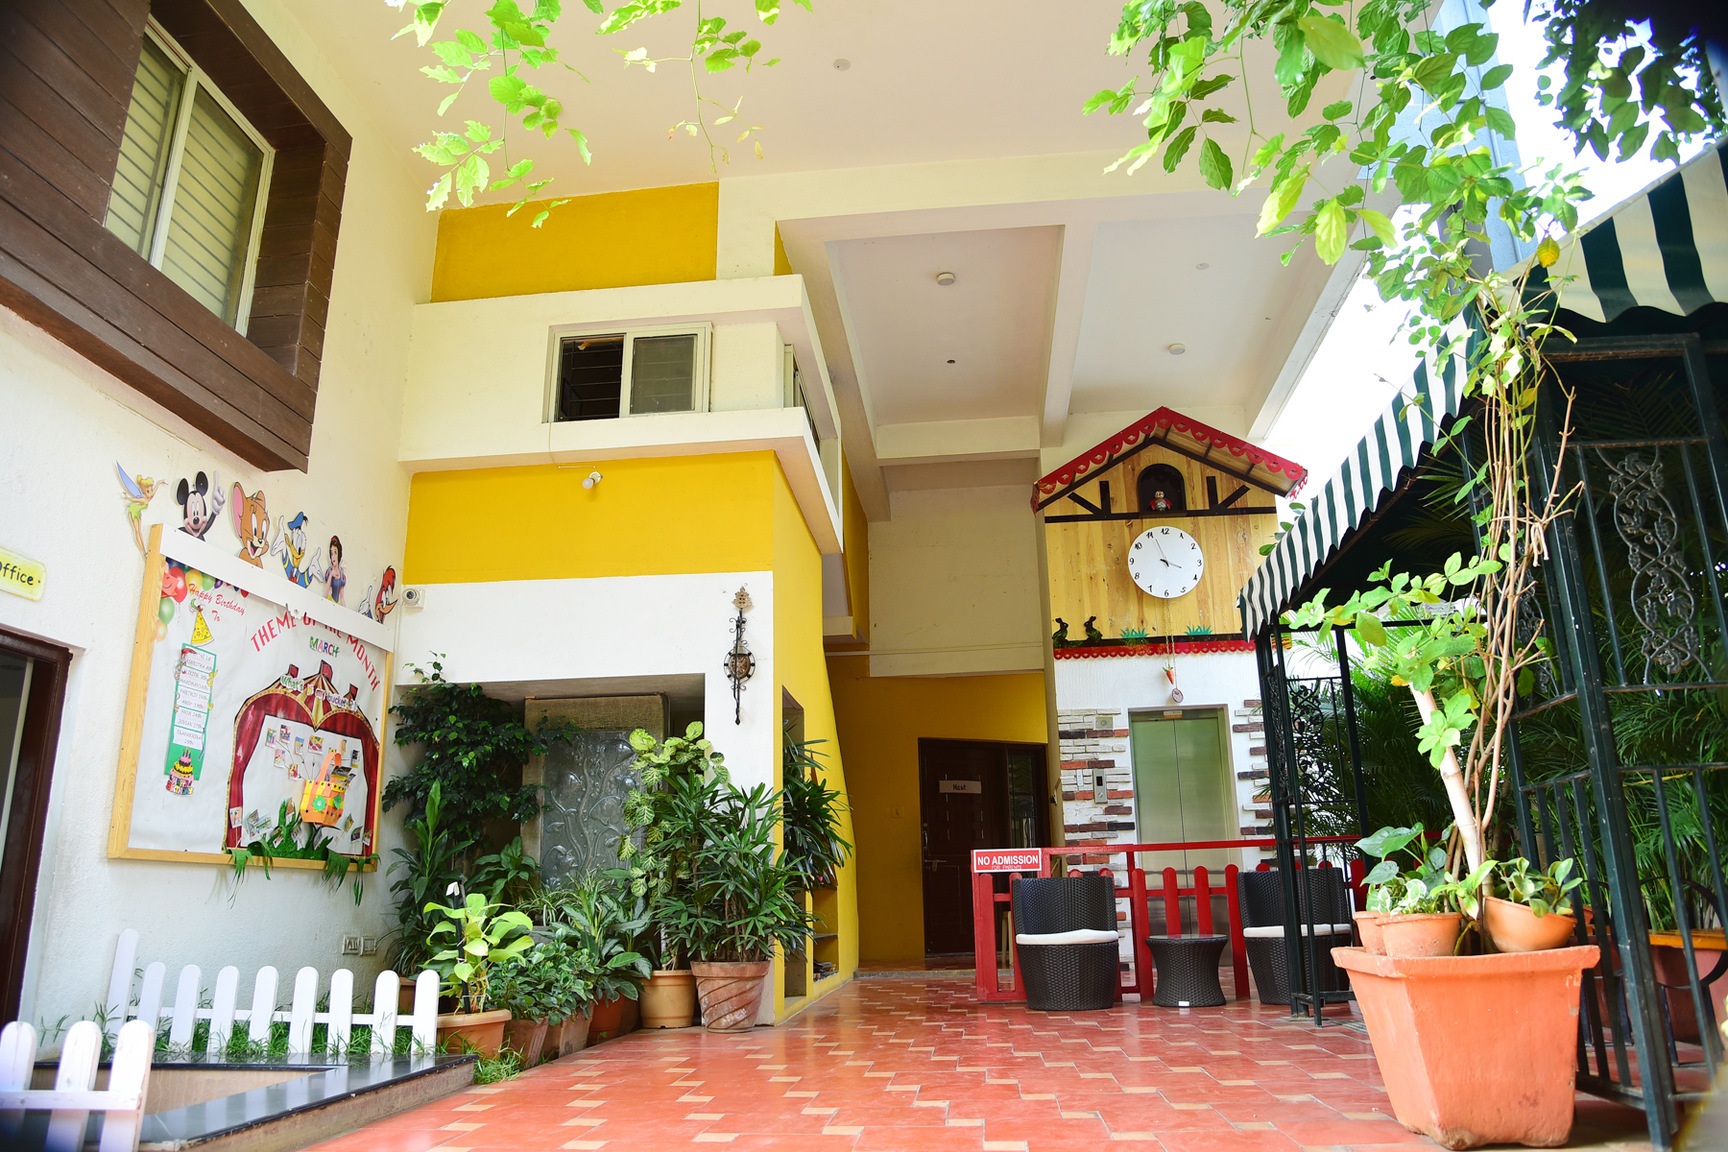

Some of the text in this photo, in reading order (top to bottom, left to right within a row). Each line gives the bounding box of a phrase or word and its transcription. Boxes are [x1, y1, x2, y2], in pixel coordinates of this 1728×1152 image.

[1146, 531, 1154, 539] 11
[1134, 542, 1143, 550] 10
[1190, 542, 1196, 550] 2
[1129, 557, 1135, 565] 9
[1197, 559, 1202, 567] 3
[1134, 572, 1140, 580] 8
[1163, 589, 1169, 597] 6
[189, 583, 245, 616] Happy Birthday
[309, 635, 340, 658] MARCH
[250, 611, 297, 653] THEME
[346, 633, 381, 692] MONTH
[977, 854, 1039, 866] NO ADMISSION
